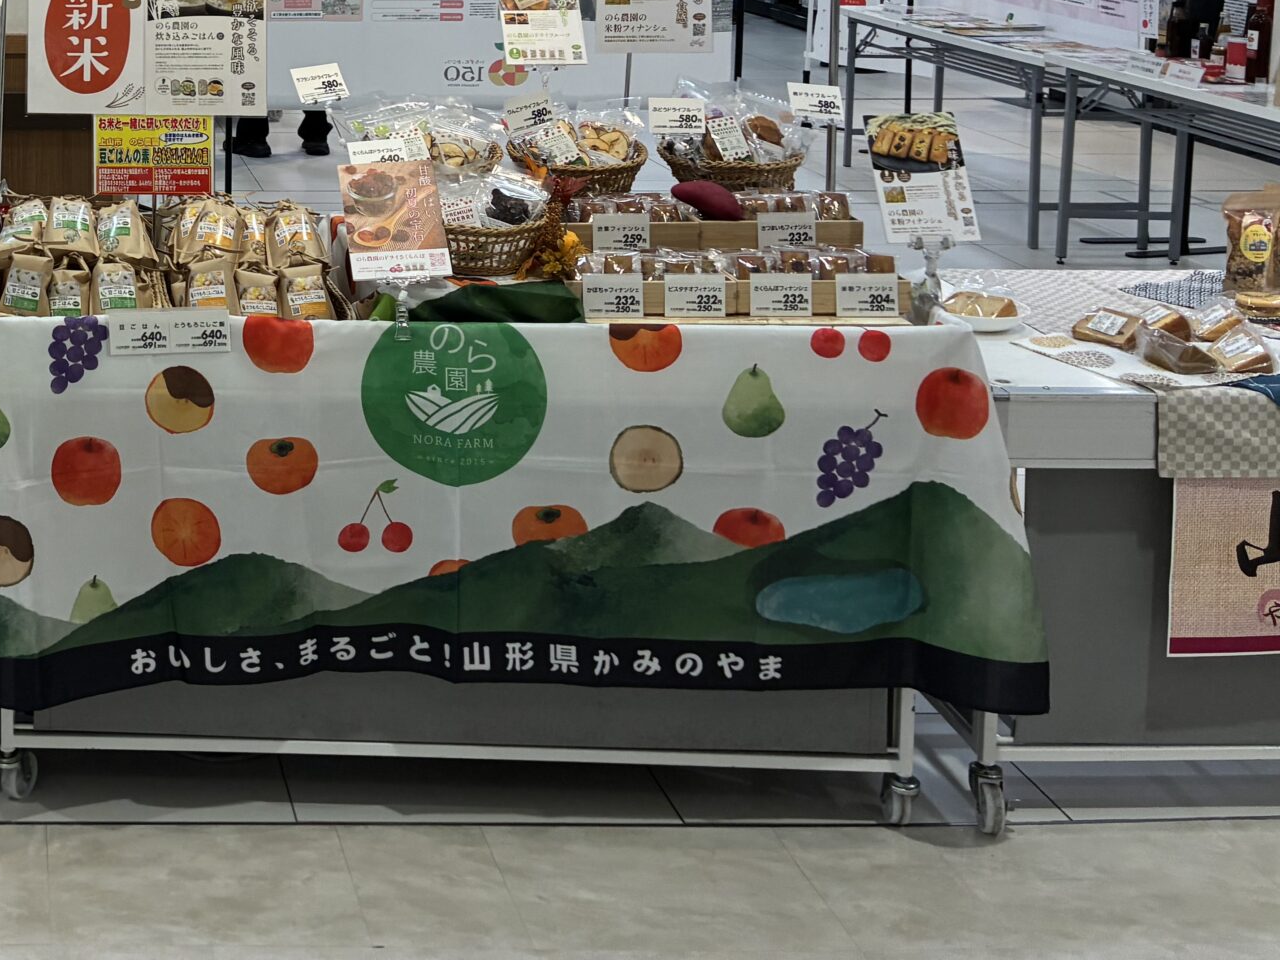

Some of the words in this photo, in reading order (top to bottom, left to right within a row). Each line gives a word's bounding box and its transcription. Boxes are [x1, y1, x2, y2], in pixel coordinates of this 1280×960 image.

[604, 13, 648, 22] のら農園の
[155, 21, 199, 30] のら農園の
[604, 23, 668, 33] 米粉フィナンシェ
[155, 31, 216, 41] 炊き込みごはん
[230, 3, 246, 76] 豊かな風味
[99, 148, 150, 164] 豆ごはんの素
[445, 208, 473, 218] PREMIUM
[447, 214, 475, 224] CHERRY
[413, 434, 452, 448] NORA
[457, 437, 495, 450] FARM
[459, 455, 488, 467] 2015
